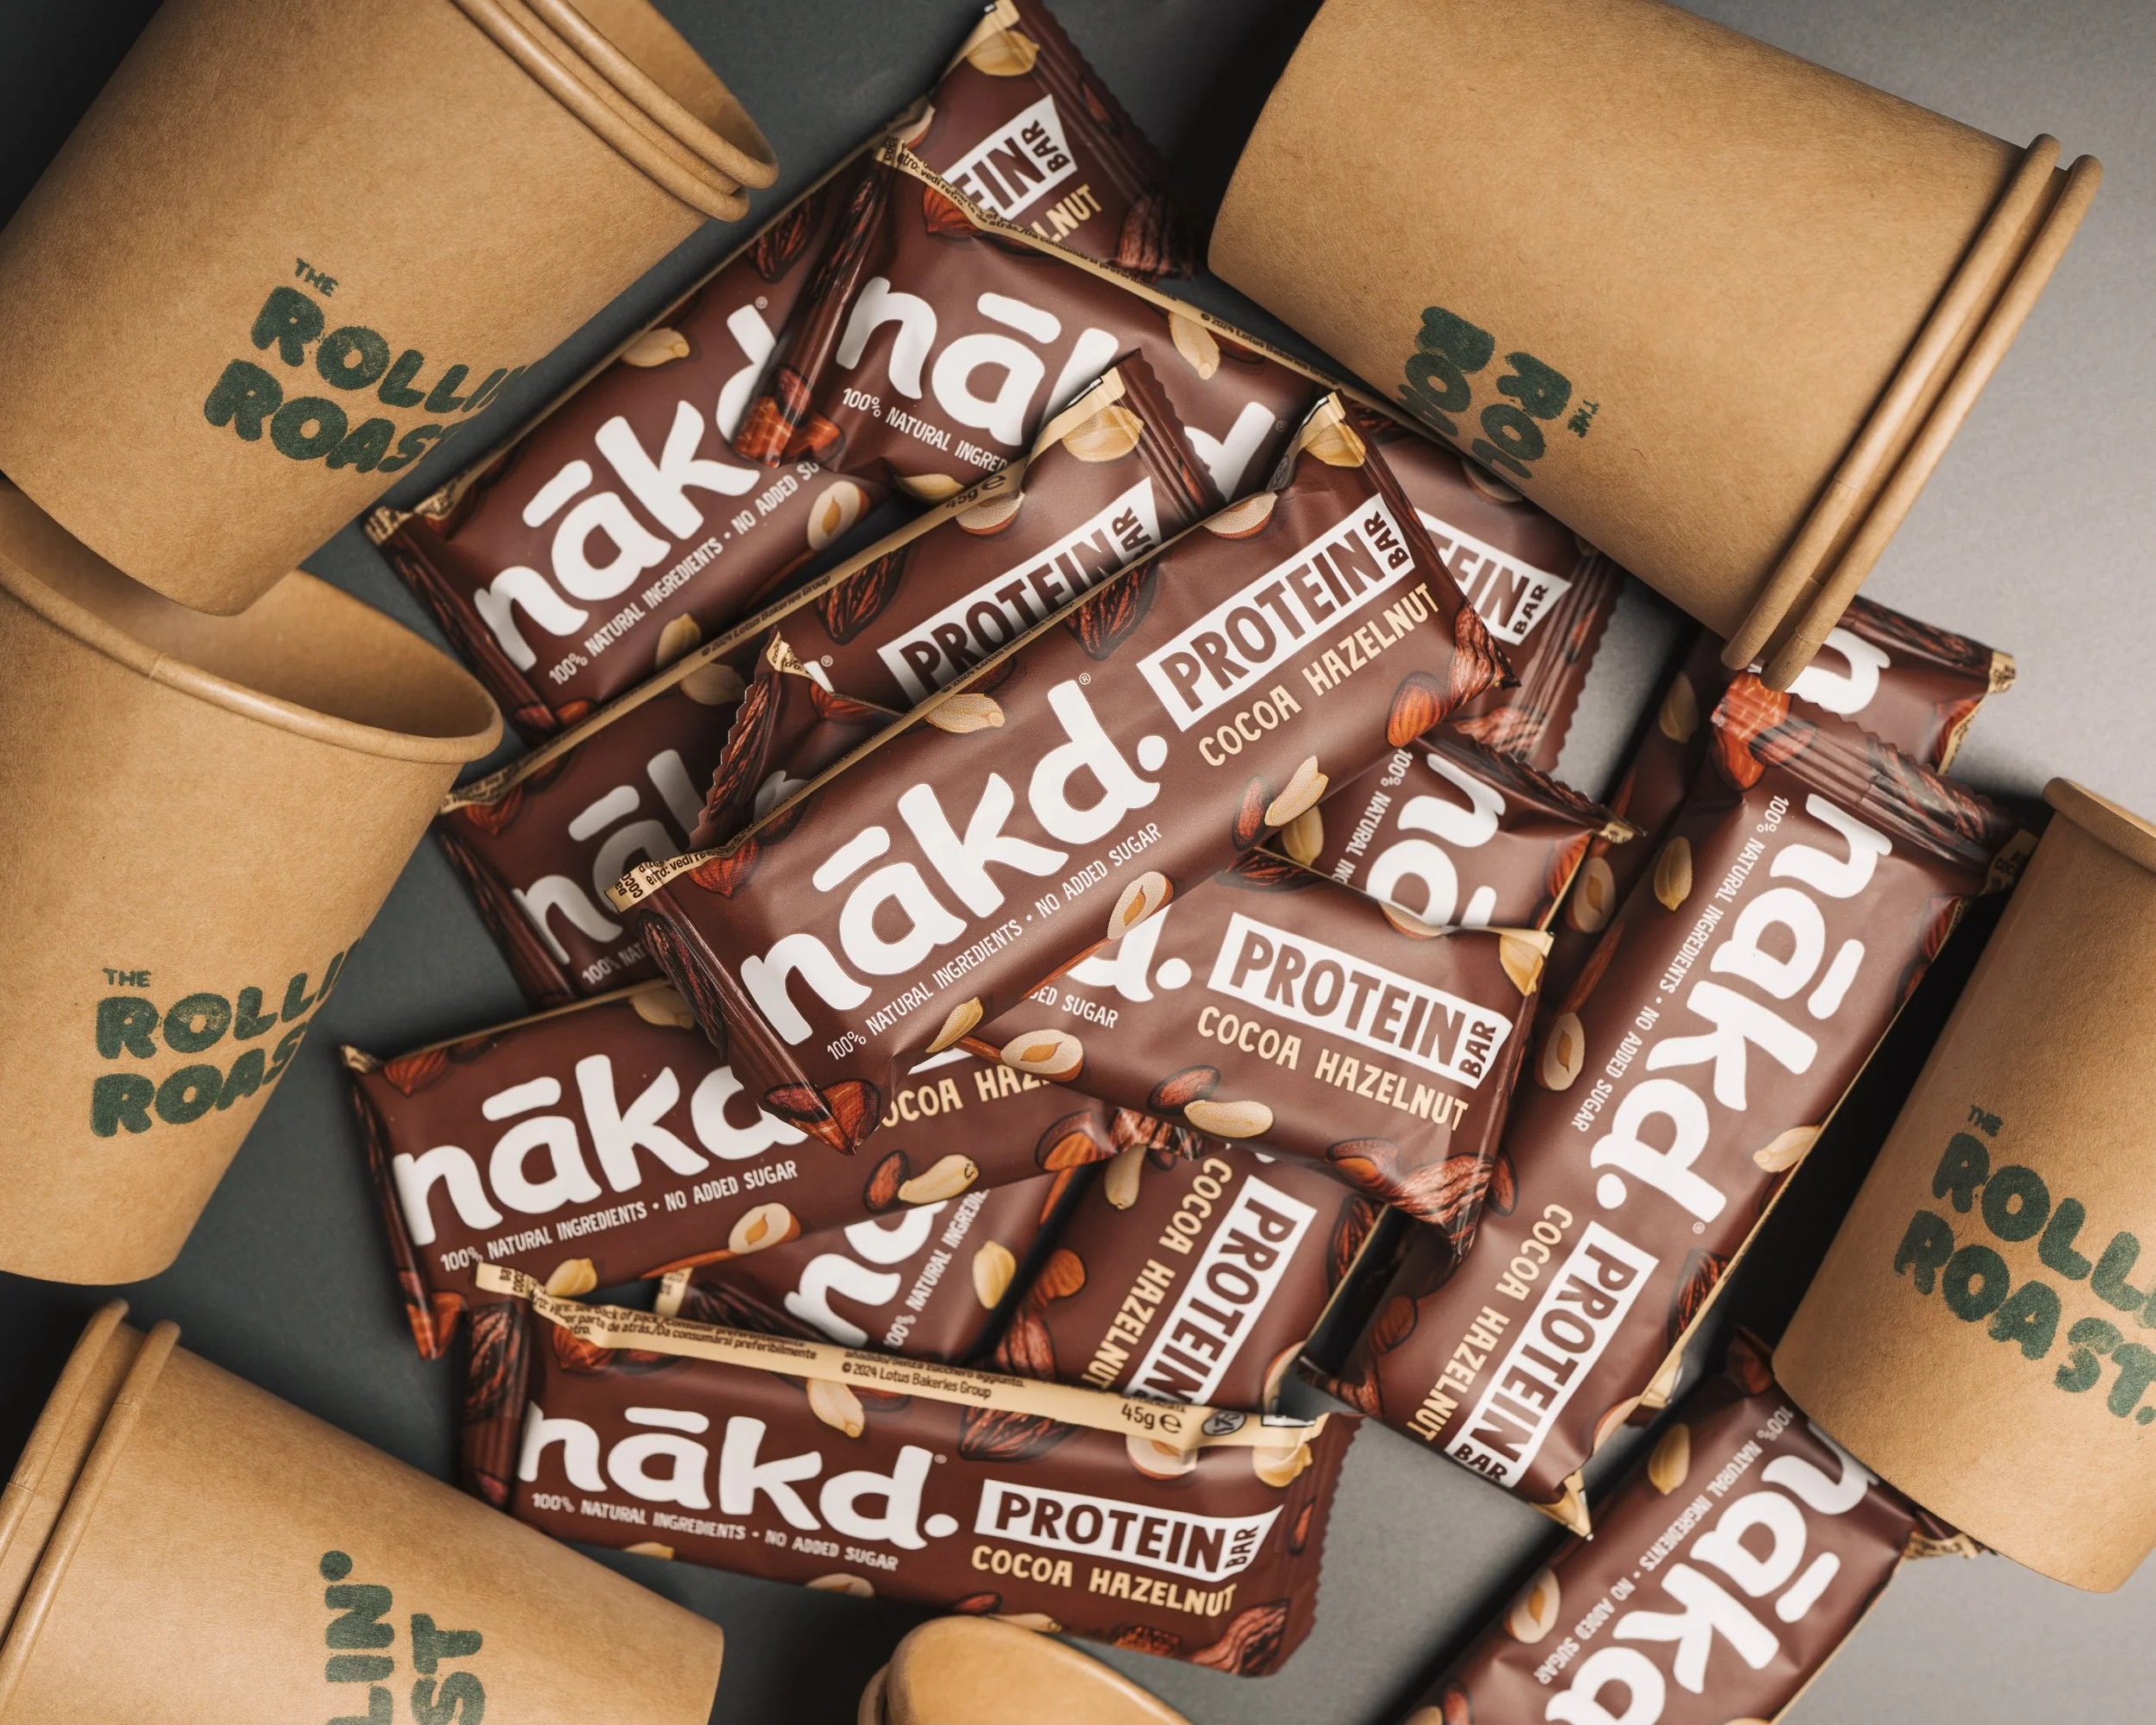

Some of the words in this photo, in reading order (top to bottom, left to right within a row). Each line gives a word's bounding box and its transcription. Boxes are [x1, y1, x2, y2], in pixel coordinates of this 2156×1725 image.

[1021, 118, 1071, 173] BAR
[292, 258, 340, 298] THE
[843, 387, 881, 418] 100%
[885, 406, 950, 453] NATURAL
[1363, 510, 1410, 570] BAR
[549, 653, 588, 686] 100%
[584, 603, 645, 658] NATURAL
[641, 537, 724, 609] INGREDIENTS
[730, 511, 757, 535] NO
[754, 475, 799, 518] ADDED
[1513, 584, 1550, 636] BAR
[1158, 527, 1382, 714] PROTEIN
[1198, 684, 1302, 768] COCOA
[1300, 582, 1440, 697] HAZELNUT
[1380, 748, 1414, 787] 100%
[1344, 790, 1393, 857] NATURAL
[1755, 793, 1791, 833] 100%
[671, 855, 693, 871] vedi
[740, 679, 1168, 1045] nākd.
[1715, 835, 1765, 904] NATURAL
[826, 1029, 868, 1061] 100%
[864, 986, 935, 1038] NATURAL
[931, 918, 1024, 992] INGREDIENTS
[1035, 892, 1060, 919] NO
[1061, 858, 1108, 906] ADDED
[1107, 821, 1163, 867] SUGAR
[1658, 900, 1720, 994] INGREDIENTS
[102, 967, 152, 988] THE
[1229, 929, 1467, 1068] PROTEIN
[1589, 794, 1893, 1224] nākd.
[1061, 994, 1119, 1029] SUGAR
[1635, 1004, 1659, 1033] NO
[1196, 1006, 1302, 1071] COCOA
[1314, 1049, 1470, 1132] HAZELNUT
[1459, 1019, 1498, 1079] BAR
[1607, 1029, 1644, 1082] ADDED
[1570, 1076, 1614, 1133] SUGAR
[1967, 1104, 2004, 1138] THE
[439, 1246, 483, 1274] 100%
[487, 1227, 554, 1260] NATURAL
[556, 1199, 648, 1243] INGREDIENTS
[665, 1191, 687, 1213] NO
[693, 1176, 740, 1206] ADDED
[744, 1160, 799, 1192] SUGAR
[1158, 1157, 1234, 1256] COCOA
[905, 1248, 953, 1313] NATURAL
[1495, 1203, 1573, 1302] COCOA
[1080, 1258, 1177, 1392] HAZELNUT
[1143, 1197, 1300, 1403] PROTEIN
[853, 1365, 877, 1378] 2024
[880, 1368, 911, 1383] Lotus
[912, 1372, 957, 1392] Bakeries
[959, 1381, 992, 1400] Group
[1406, 1307, 1511, 1441] HAZELNUT
[1471, 1241, 1637, 1464] PROTEIN
[1121, 1403, 1156, 1430] 45g
[518, 1402, 959, 1551] nākd.
[1451, 1443, 1507, 1482] BAR
[1705, 1438, 1764, 1499] NATURAL
[531, 1492, 575, 1513] 100%
[580, 1498, 648, 1526] NATURAL
[652, 1514, 748, 1541] INGREDIENTS
[764, 1530, 788, 1549] NO
[791, 1534, 841, 1562] ADDED
[843, 1546, 899, 1573] SUGAR
[993, 1490, 1225, 1574] PROTEIN
[1224, 1522, 1260, 1571] BAR
[1639, 1493, 1714, 1573] INGREDIENTS
[970, 1545, 1074, 1589] COCOA
[1087, 1566, 1238, 1618] HAZELNUT
[1610, 1568, 1637, 1602] NO
[1574, 1596, 1616, 1641] ADDED
[1532, 1636, 1581, 1686] SUGAR
